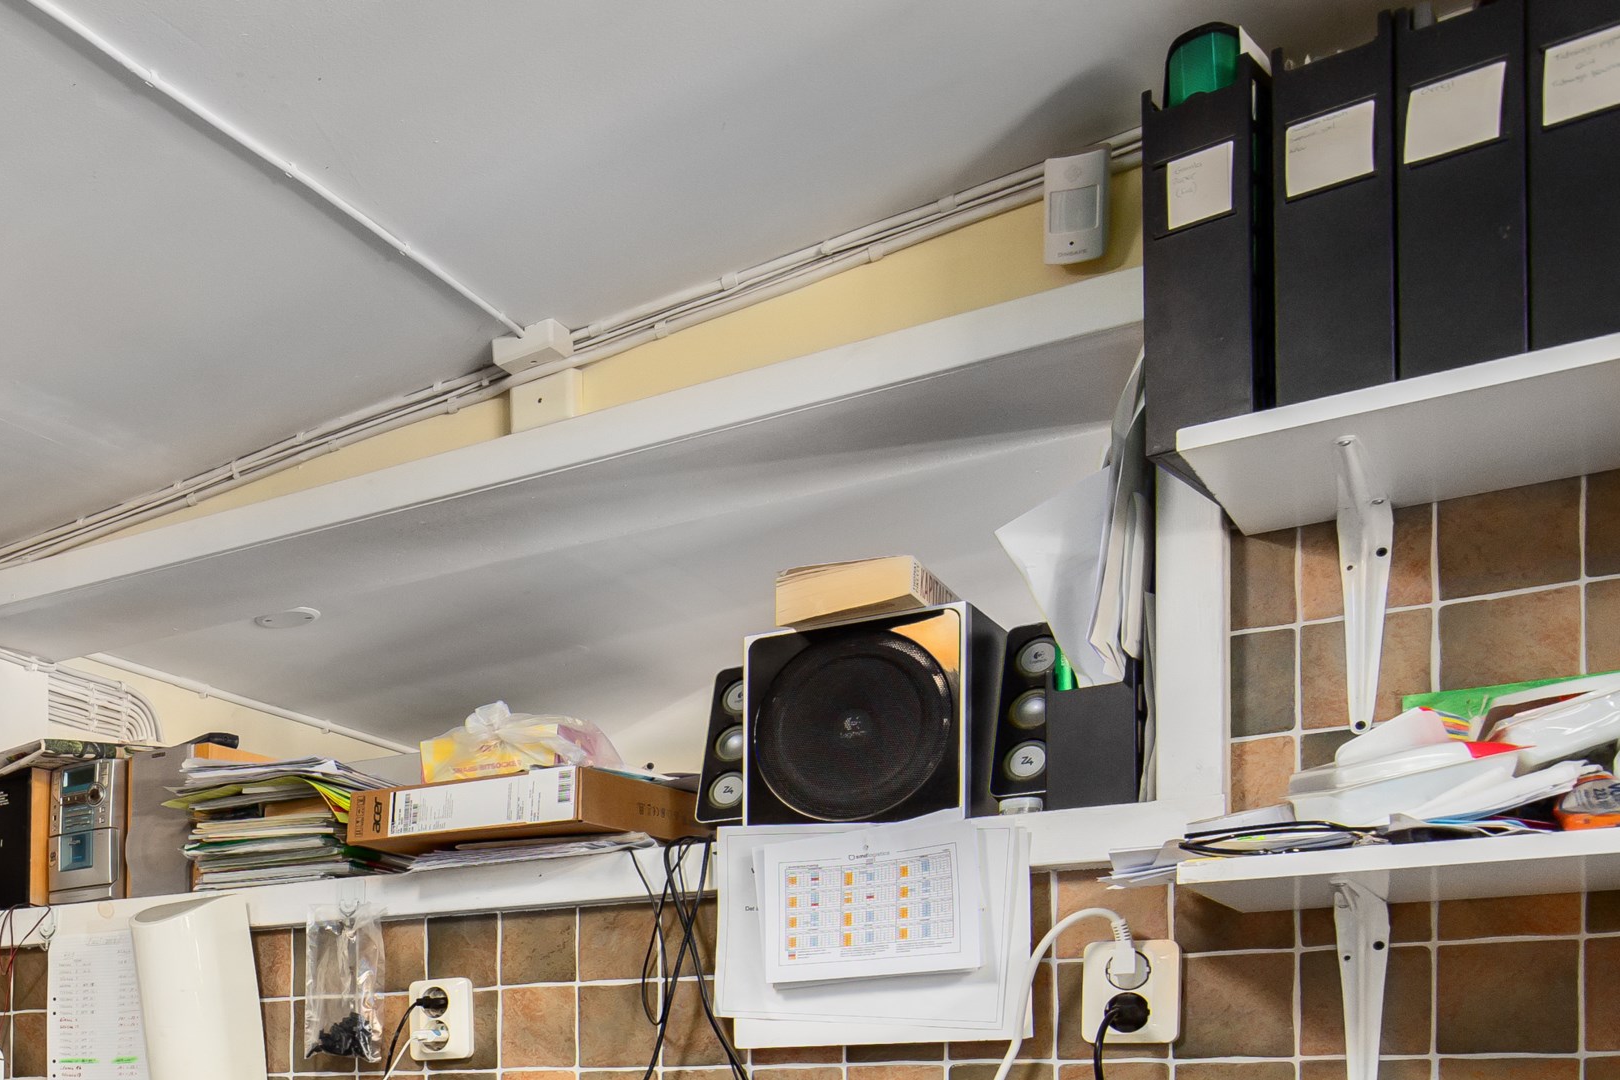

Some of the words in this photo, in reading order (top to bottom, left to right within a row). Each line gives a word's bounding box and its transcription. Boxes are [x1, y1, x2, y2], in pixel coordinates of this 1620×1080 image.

[1021, 756, 1034, 766] Z4
[722, 785, 734, 795] Z4
[372, 796, 382, 834] acer
